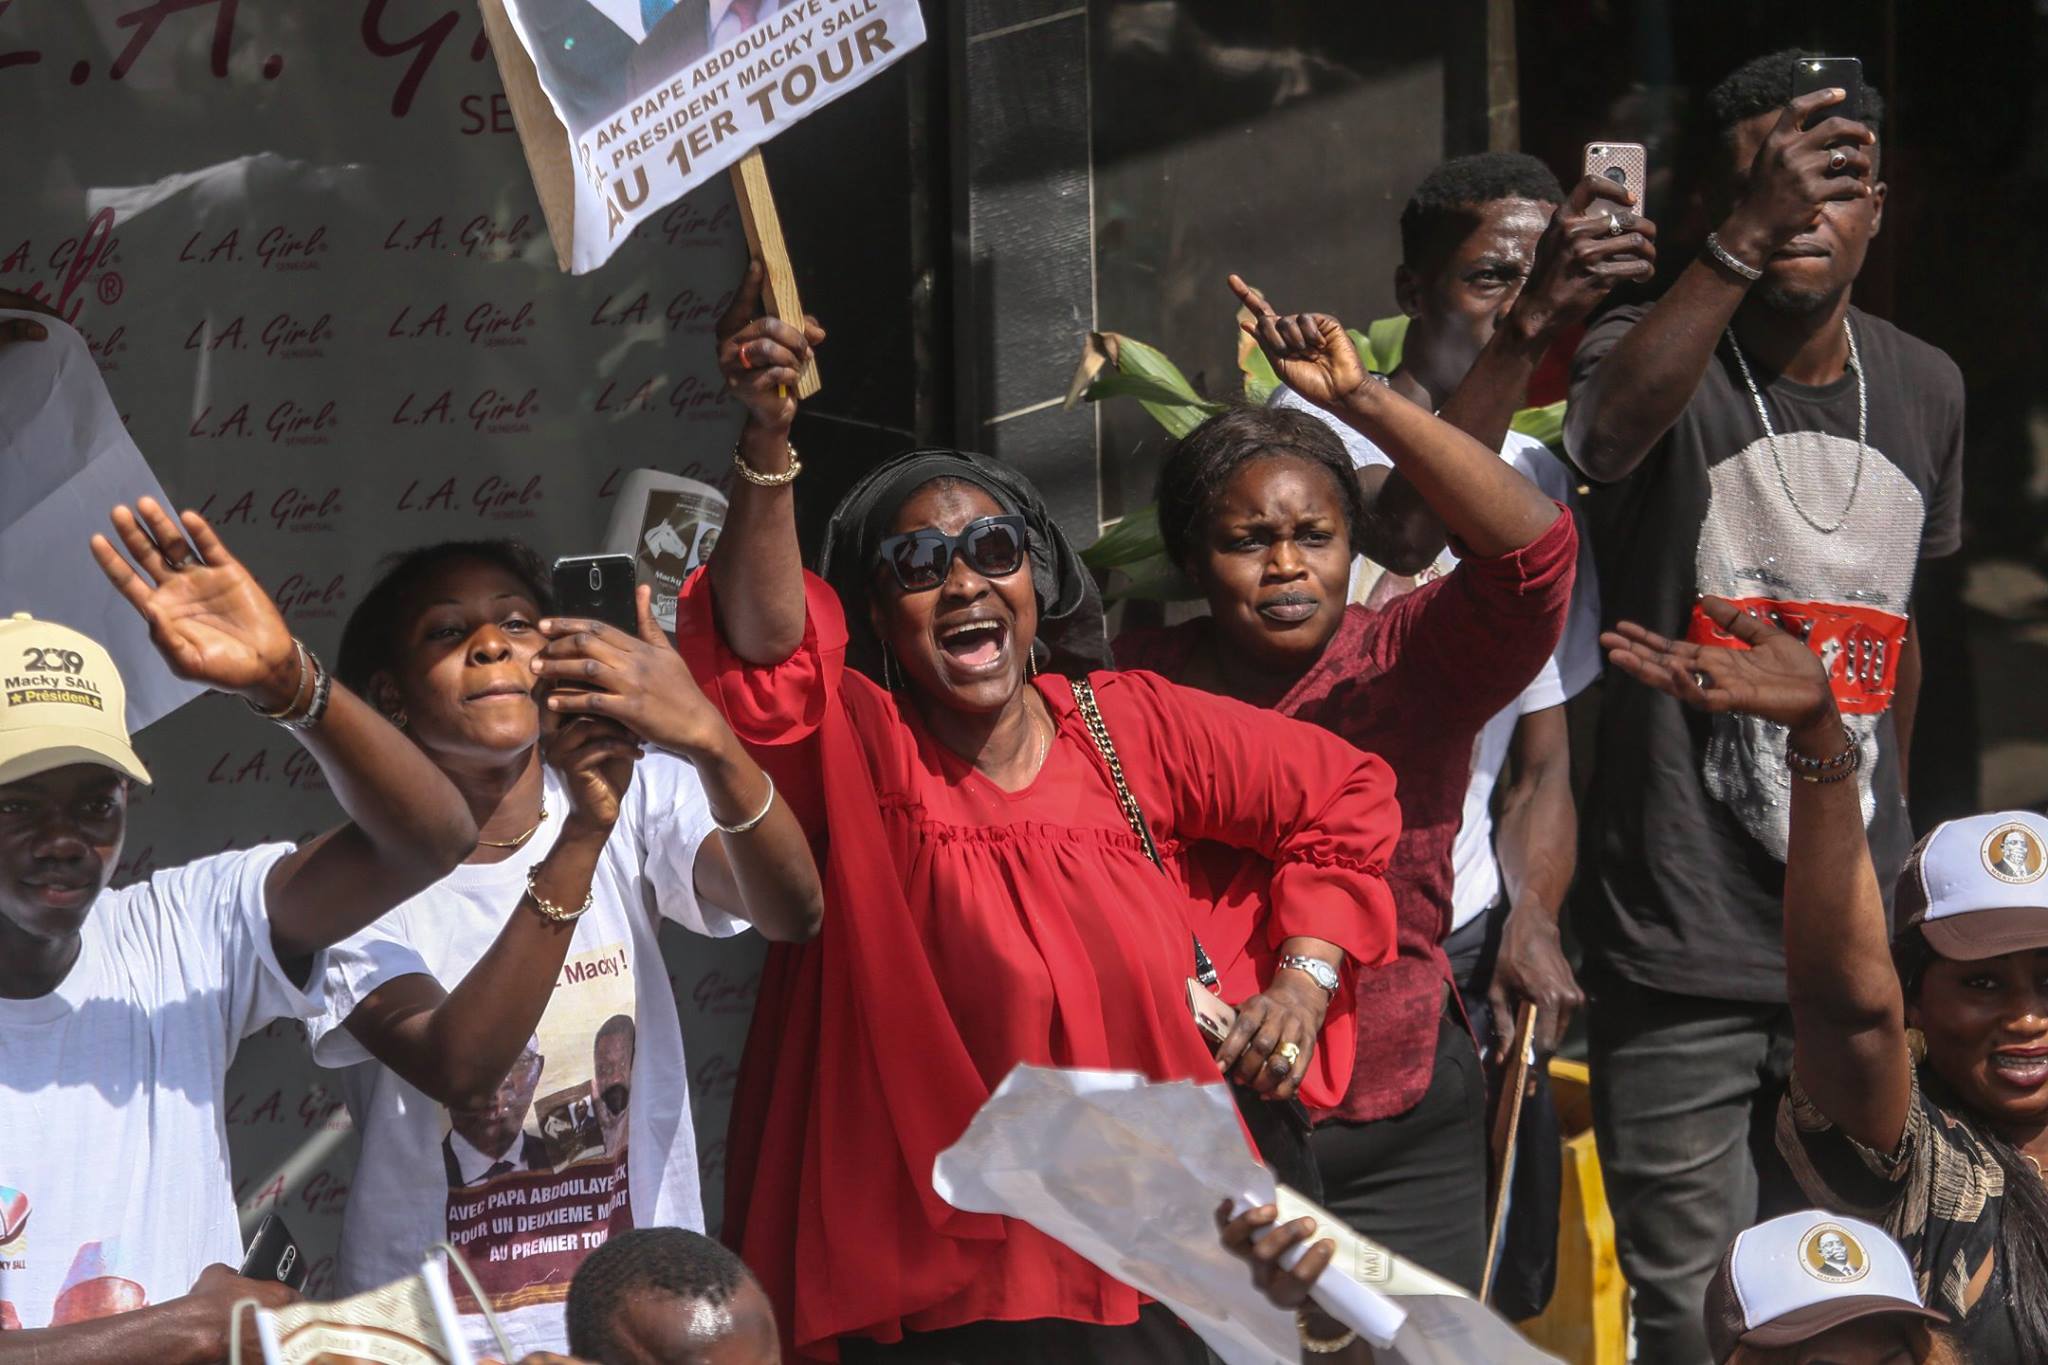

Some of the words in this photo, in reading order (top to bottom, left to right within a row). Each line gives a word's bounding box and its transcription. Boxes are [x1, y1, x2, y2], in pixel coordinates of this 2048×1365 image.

[596, 116, 627, 149] AK
[630, 79, 686, 126] PAPE
[692, 0, 823, 88] ABDOULAYE
[611, 80, 730, 169] PRESIDENT
[737, 29, 814, 89] MACKY
[821, 0, 878, 37] SALL
[607, 165, 650, 242] AU
[666, 109, 740, 178] 1ER
[746, 18, 896, 126] TOUR
[179, 227, 243, 263] L.A.
[256, 224, 328, 269] Girl
[383, 215, 448, 250] L.A.
[458, 213, 533, 257] Girl
[184, 315, 248, 350] L.A.
[260, 312, 334, 357] Girl
[387, 303, 452, 338] L.A.
[463, 301, 536, 344] Girl
[188, 402, 253, 438] L.A.
[265, 399, 337, 443] Girl
[391, 391, 456, 425] L.A.
[467, 387, 540, 432] Girl
[270, 487, 343, 530] Girl
[396, 477, 460, 511] L.A.
[471, 474, 544, 517] Girl
[274, 572, 346, 616] Girl
[5, 674, 60, 690] Macky
[65, 676, 101, 695] SALL
[207, 749, 270, 785] L.A.
[449, 1201, 485, 1221] AVEC
[487, 1189, 527, 1211] PAPA
[530, 1175, 615, 1204] ABDOULAYE
[450, 1223, 488, 1247] POUR
[492, 1216, 513, 1235] UN
[517, 1205, 593, 1233] DEUXIEME
[489, 1244, 508, 1263] AU
[511, 1233, 578, 1261] PREMIER
